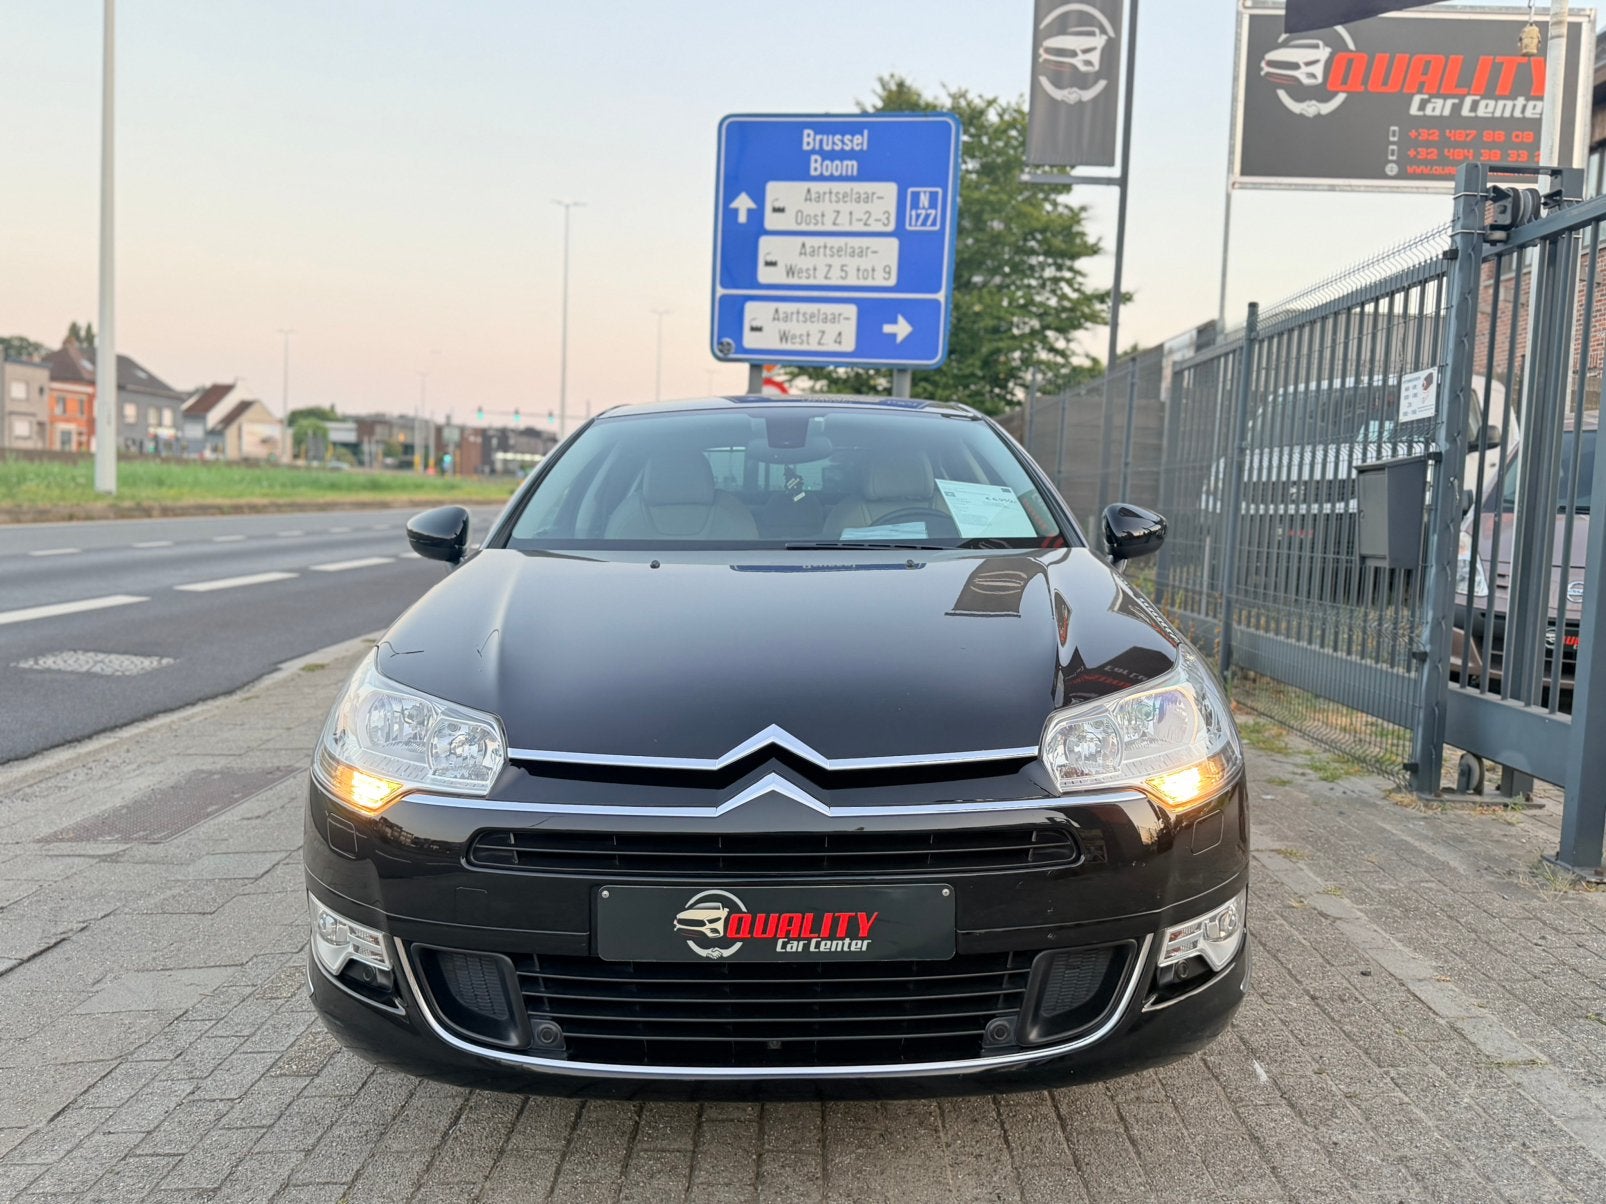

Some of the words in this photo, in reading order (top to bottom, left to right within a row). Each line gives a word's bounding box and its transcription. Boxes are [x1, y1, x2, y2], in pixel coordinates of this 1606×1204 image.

[1327, 52, 1548, 96] QUALITY
[1409, 94, 1459, 116] Car
[1461, 95, 1544, 118] Cente
[802, 129, 868, 151] Brussel
[1408, 129, 1440, 142] +32
[1445, 129, 1477, 142] 487
[1407, 147, 1439, 160] +32
[1444, 148, 1474, 161] 484
[809, 154, 859, 176] Boom
[804, 187, 885, 204] Aartselaar-
[919, 191, 930, 209] N
[795, 209, 826, 226] Oost
[910, 209, 936, 226] 177
[798, 241, 879, 258] Aartselaar-
[785, 264, 817, 280] West
[856, 265, 876, 281] tot
[882, 265, 892, 281] 9
[772, 307, 851, 324] Aartselaar-
[778, 329, 810, 345] West
[727, 912, 880, 938] QUALITY
[776, 938, 808, 952] Car
[809, 938, 872, 952] Center
